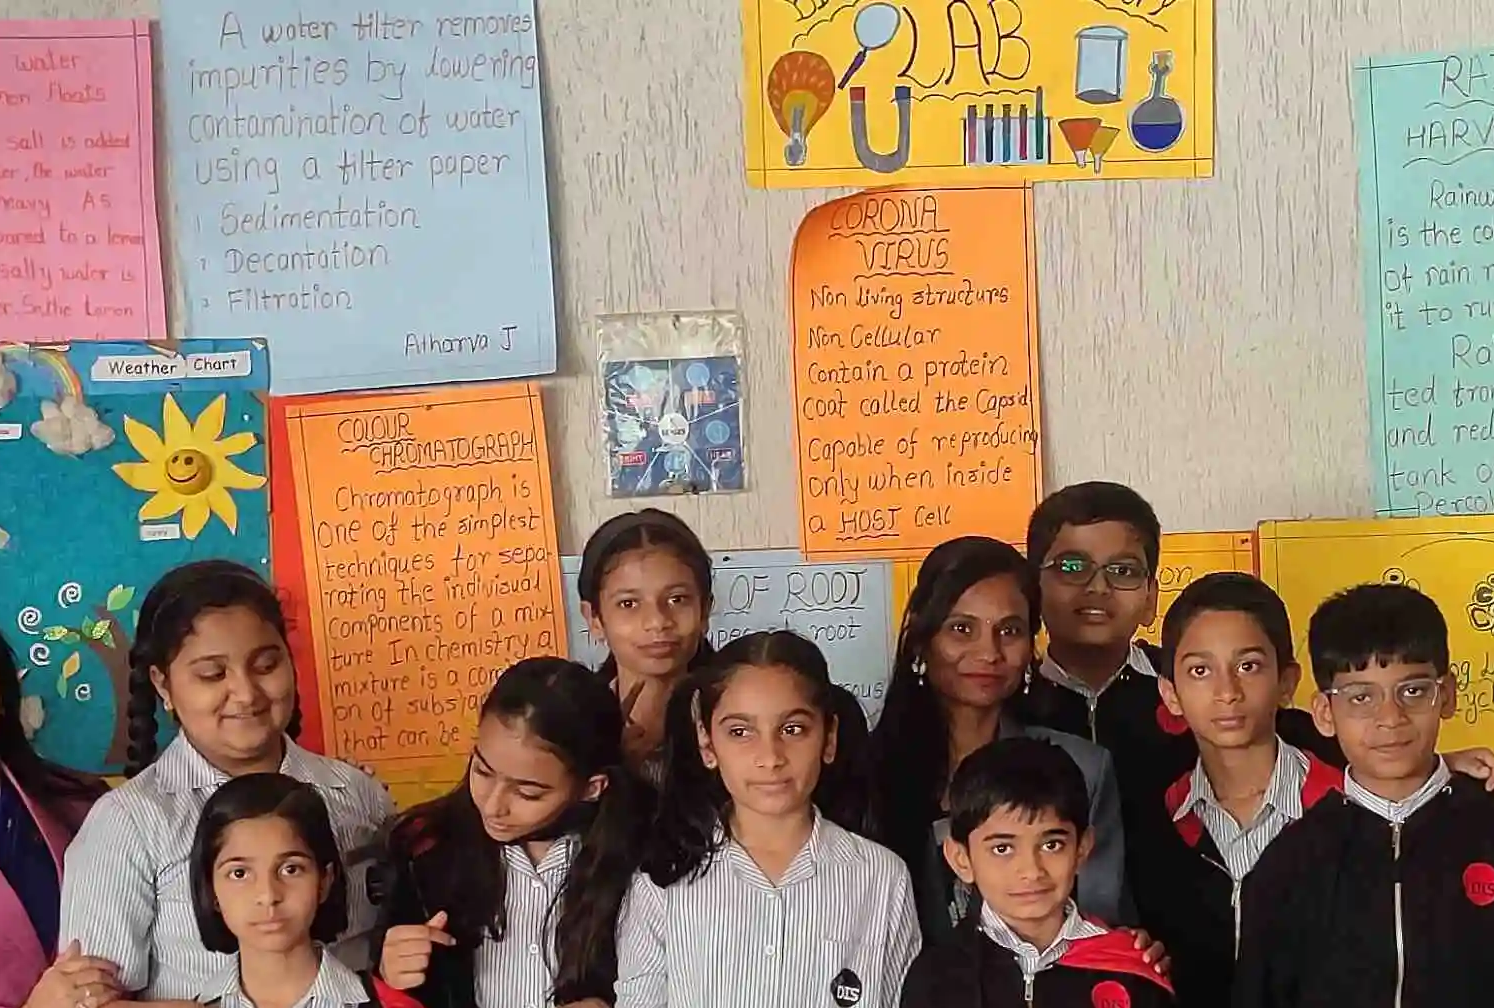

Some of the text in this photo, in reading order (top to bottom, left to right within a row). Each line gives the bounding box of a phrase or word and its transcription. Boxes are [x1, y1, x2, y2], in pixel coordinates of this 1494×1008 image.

[221, 11, 531, 49] A water filter removes
[898, 0, 1031, 88] LAB
[188, 47, 536, 101] impurities by lowering
[221, 202, 419, 236] Sedimentation
[831, 196, 939, 231] CORONA
[225, 241, 389, 273] Decantation
[857, 239, 948, 270] VIRUS
[228, 286, 353, 311] Filtration
[404, 326, 518, 355] Atharva J
[809, 326, 845, 349] Non
[108, 357, 237, 376] Weather Chart
[338, 413, 413, 443] COLOUR
[1389, 418, 1435, 447] and
[371, 433, 534, 467] CHROMATOGRAPH
[868, 468, 933, 492] when
[947, 465, 1012, 485] inside
[336, 475, 531, 514] Chromatograph is
[317, 507, 539, 548] One of the simplest
[809, 506, 952, 532] a HOST Cell
[730, 568, 868, 610] OF ROOT
[835, 986, 859, 1002] DIS
